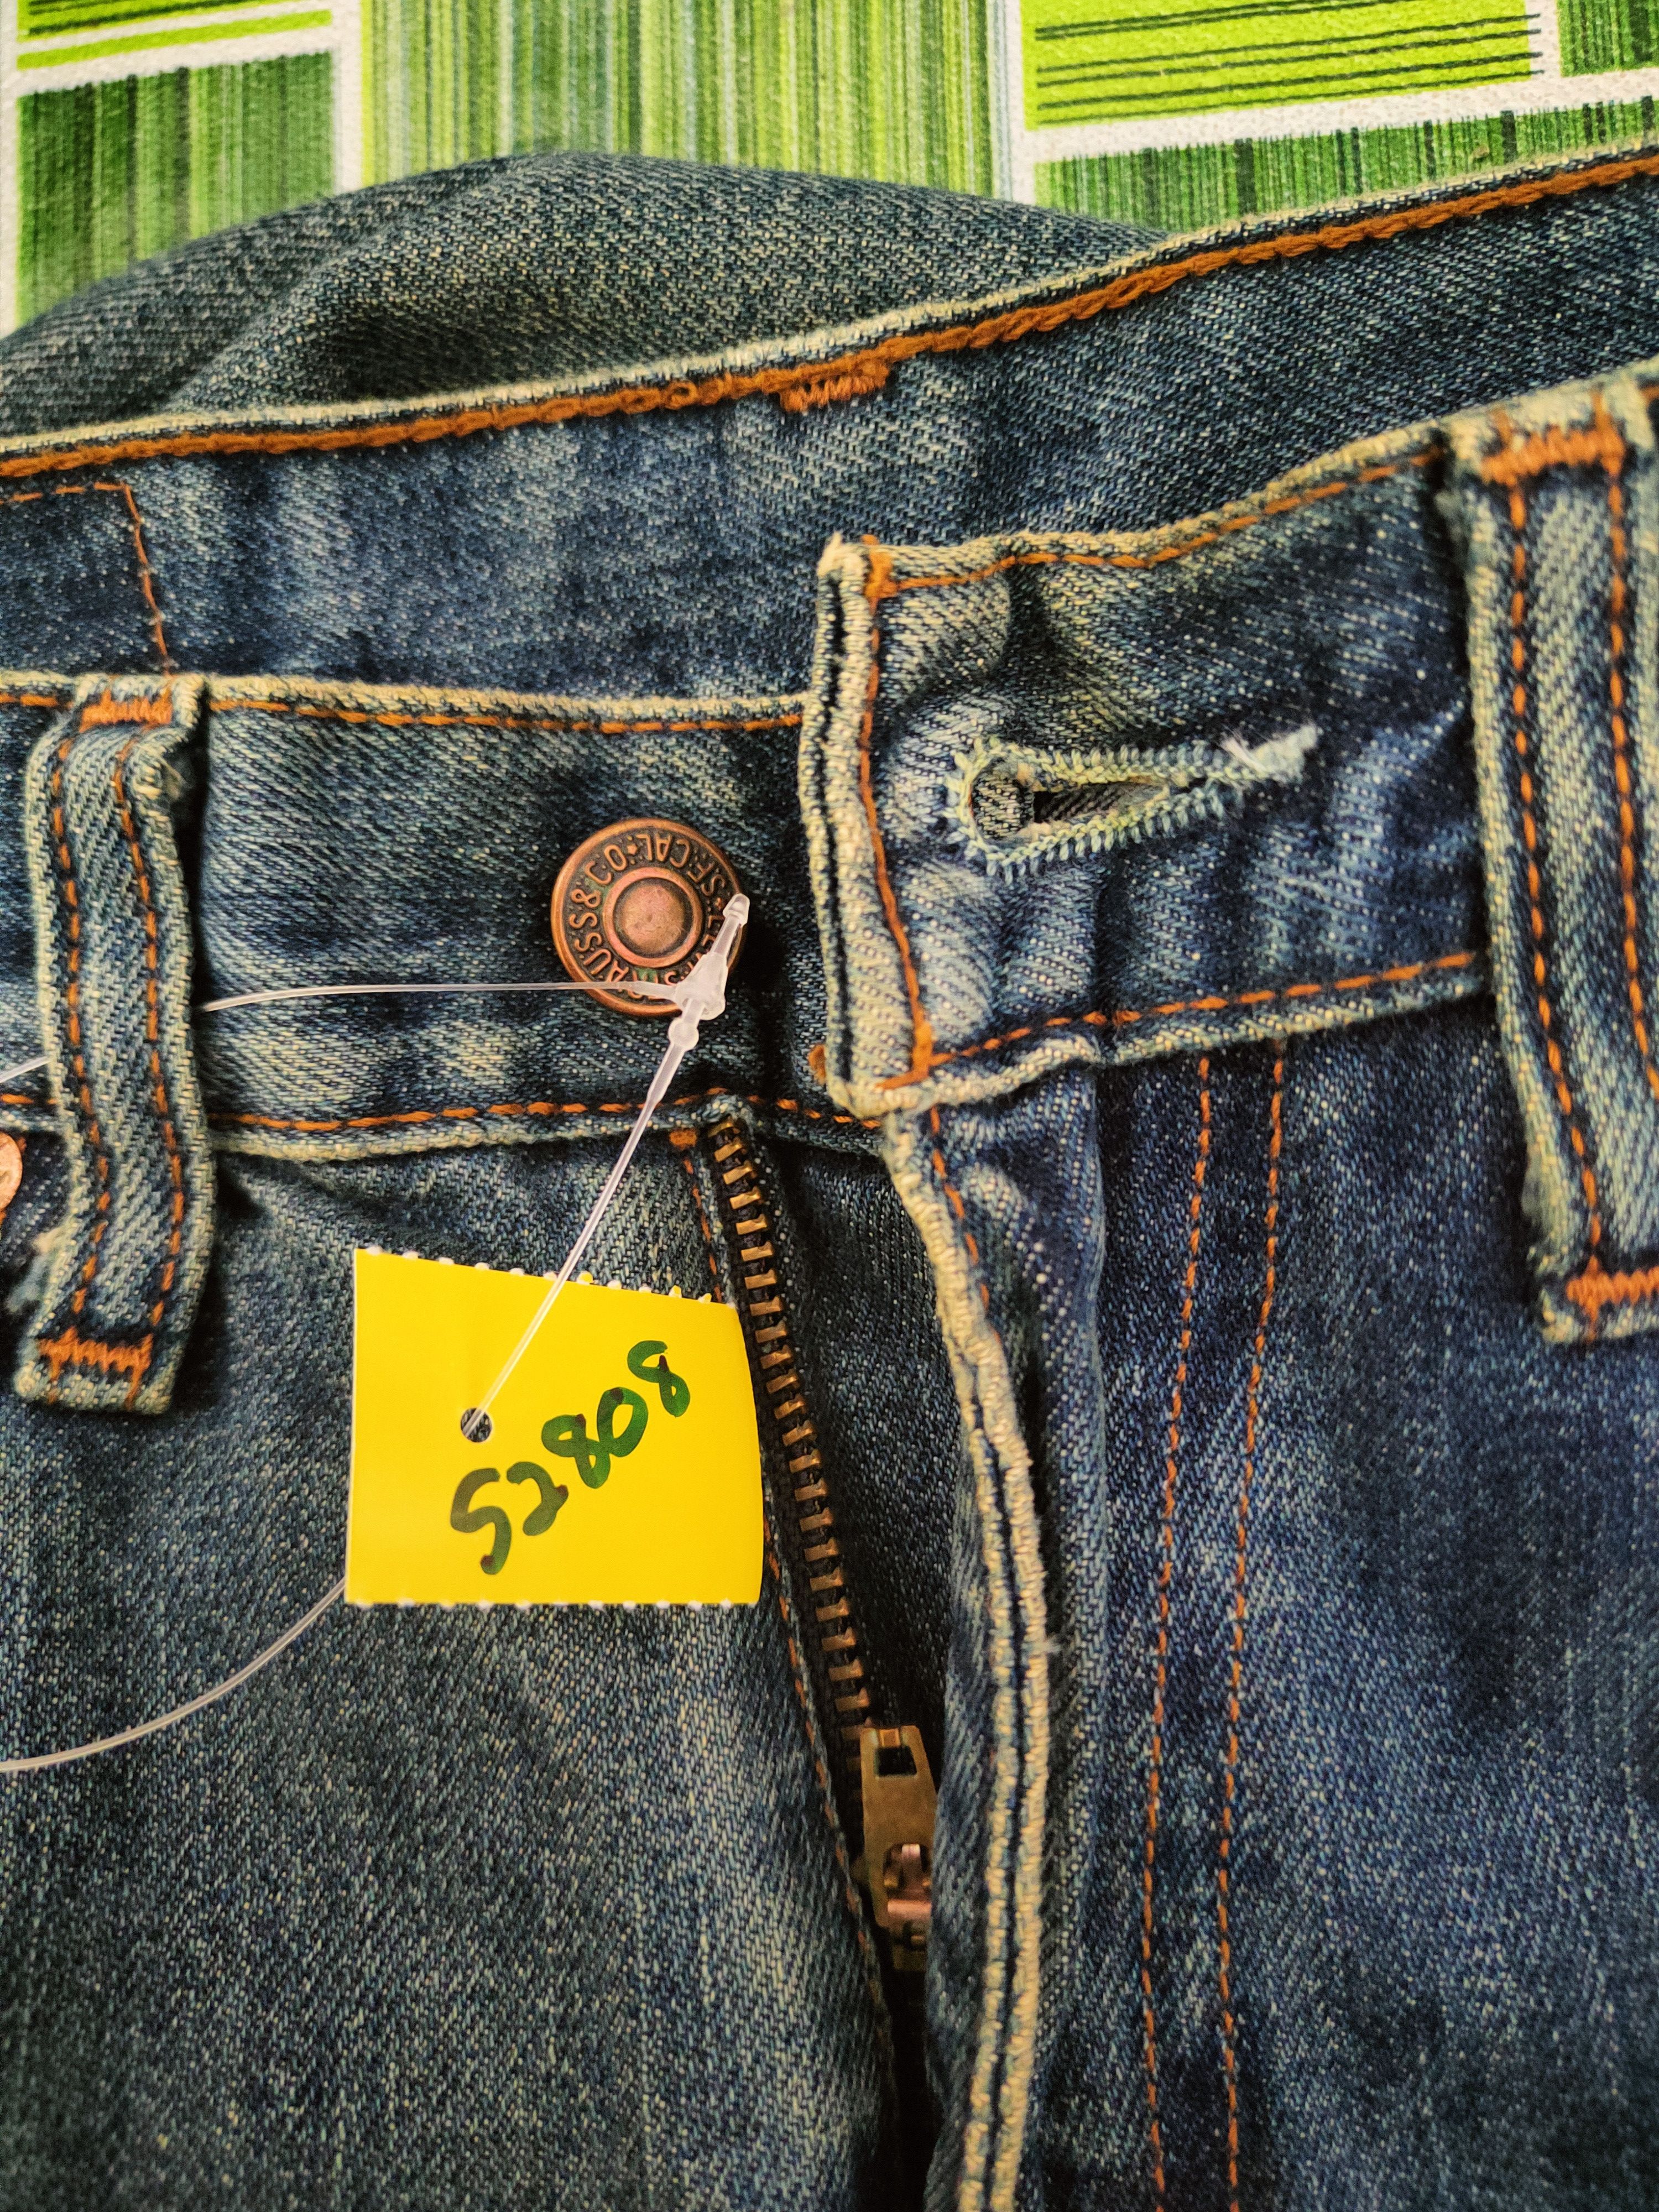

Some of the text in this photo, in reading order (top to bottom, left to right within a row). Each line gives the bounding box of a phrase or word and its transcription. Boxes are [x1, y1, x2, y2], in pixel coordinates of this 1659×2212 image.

[585, 844, 627, 885] CO
[636, 833, 690, 868] CAL
[571, 889, 602, 909] &
